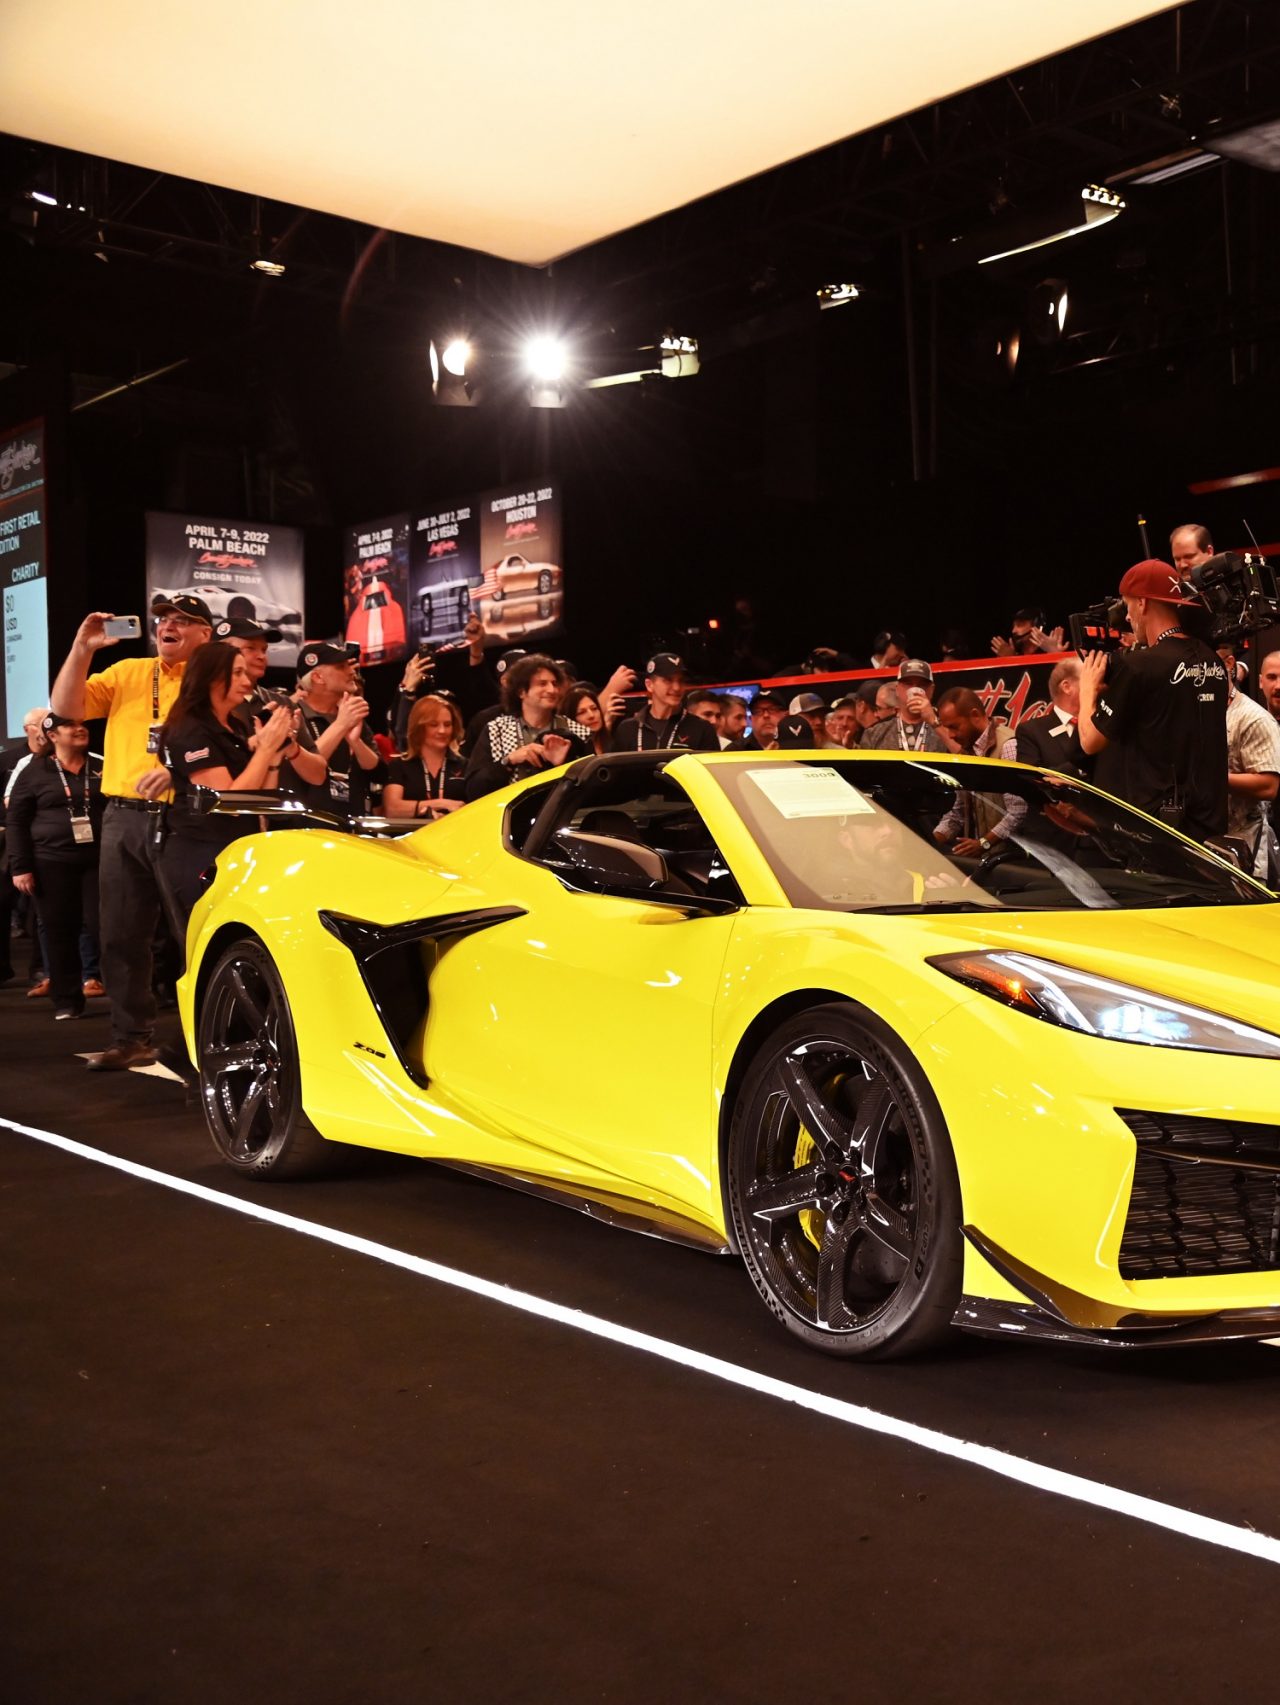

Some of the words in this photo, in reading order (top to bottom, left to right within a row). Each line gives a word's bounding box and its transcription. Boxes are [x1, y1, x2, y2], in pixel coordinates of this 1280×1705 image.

[537, 487, 552, 501] 2022
[18, 509, 41, 531] RETAIL
[457, 507, 470, 520] 2022
[506, 505, 536, 524] HOUSTON
[185, 524, 218, 538] APRIL
[220, 527, 240, 541] 7-9,
[243, 530, 270, 544] 2022
[427, 528, 439, 542] LAS
[439, 523, 459, 538] VEGAS
[0, 535, 20, 555] DITION
[188, 537, 223, 551] PALM
[226, 541, 267, 556] BEACH
[359, 545, 374, 559] PALM
[374, 540, 392, 555] BEACH
[12, 561, 39, 583] CHARITY
[193, 571, 233, 582] CONSIGN
[234, 575, 262, 585] TODAY
